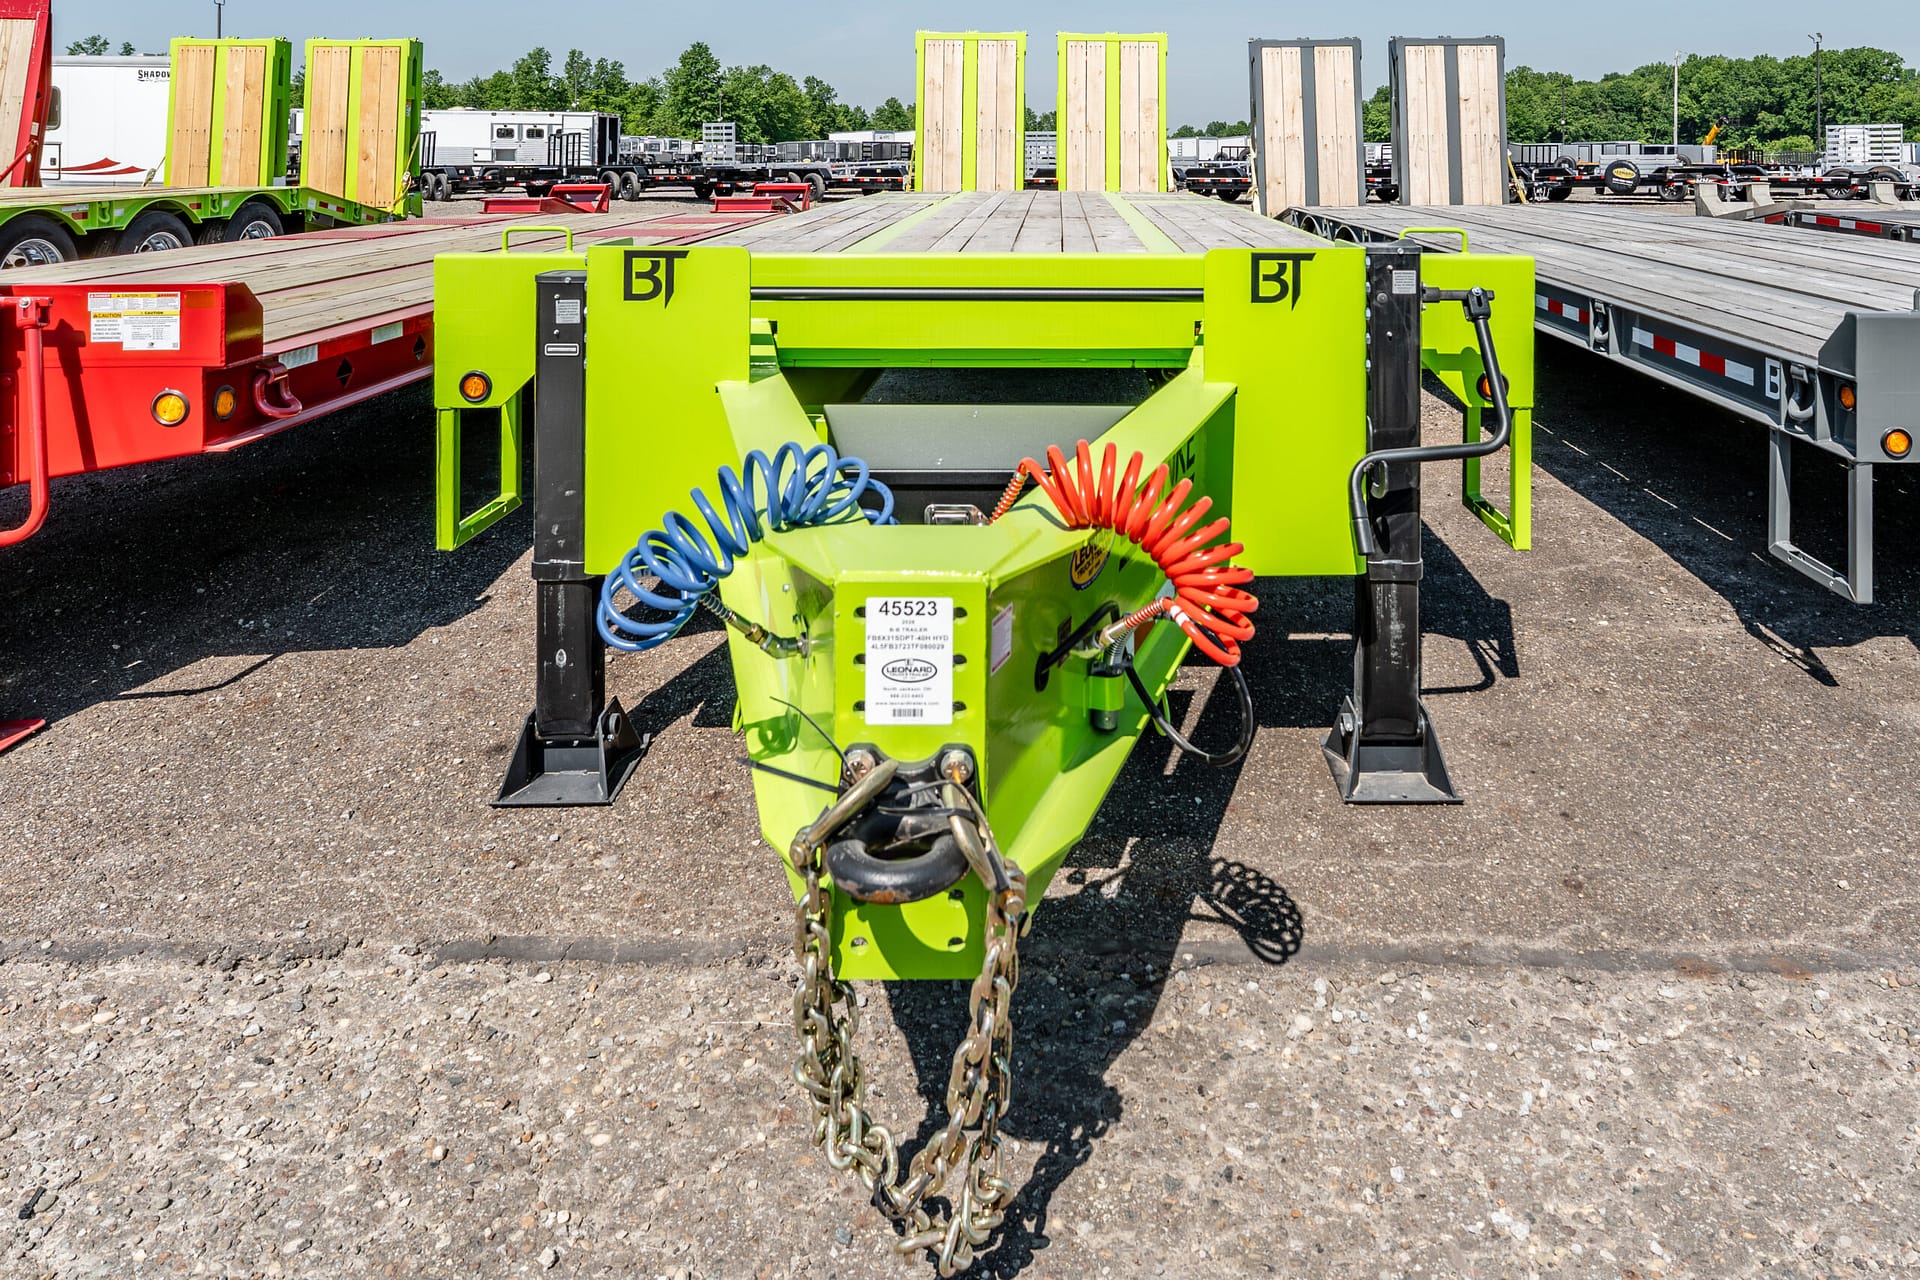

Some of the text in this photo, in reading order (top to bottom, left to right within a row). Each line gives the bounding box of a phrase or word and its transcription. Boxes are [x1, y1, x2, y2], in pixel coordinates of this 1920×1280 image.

[624, 250, 689, 309] BT
[1251, 252, 1316, 311] BT
[879, 600, 937, 616] 45523
